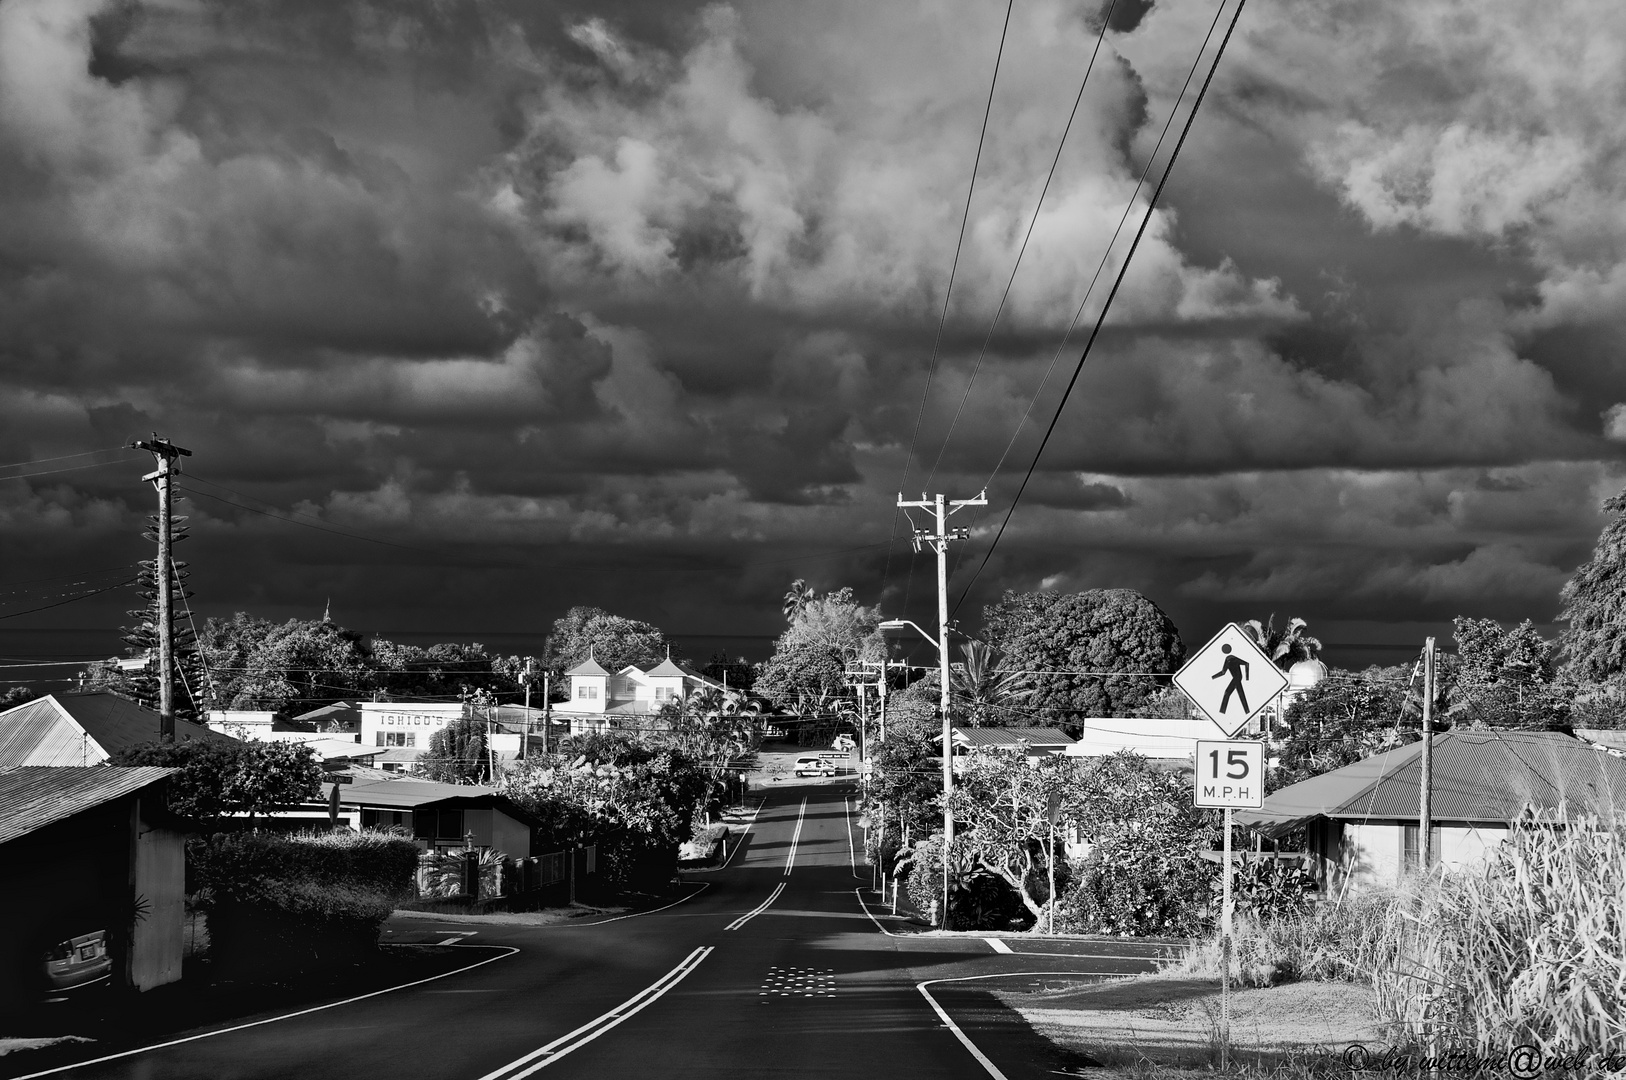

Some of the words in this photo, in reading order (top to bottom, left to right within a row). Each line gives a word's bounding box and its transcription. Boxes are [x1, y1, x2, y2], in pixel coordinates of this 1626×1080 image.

[381, 715, 443, 726] ISHIGO'S
[1209, 749, 1250, 780] 15
[1203, 785, 1254, 799] M.P.H.
